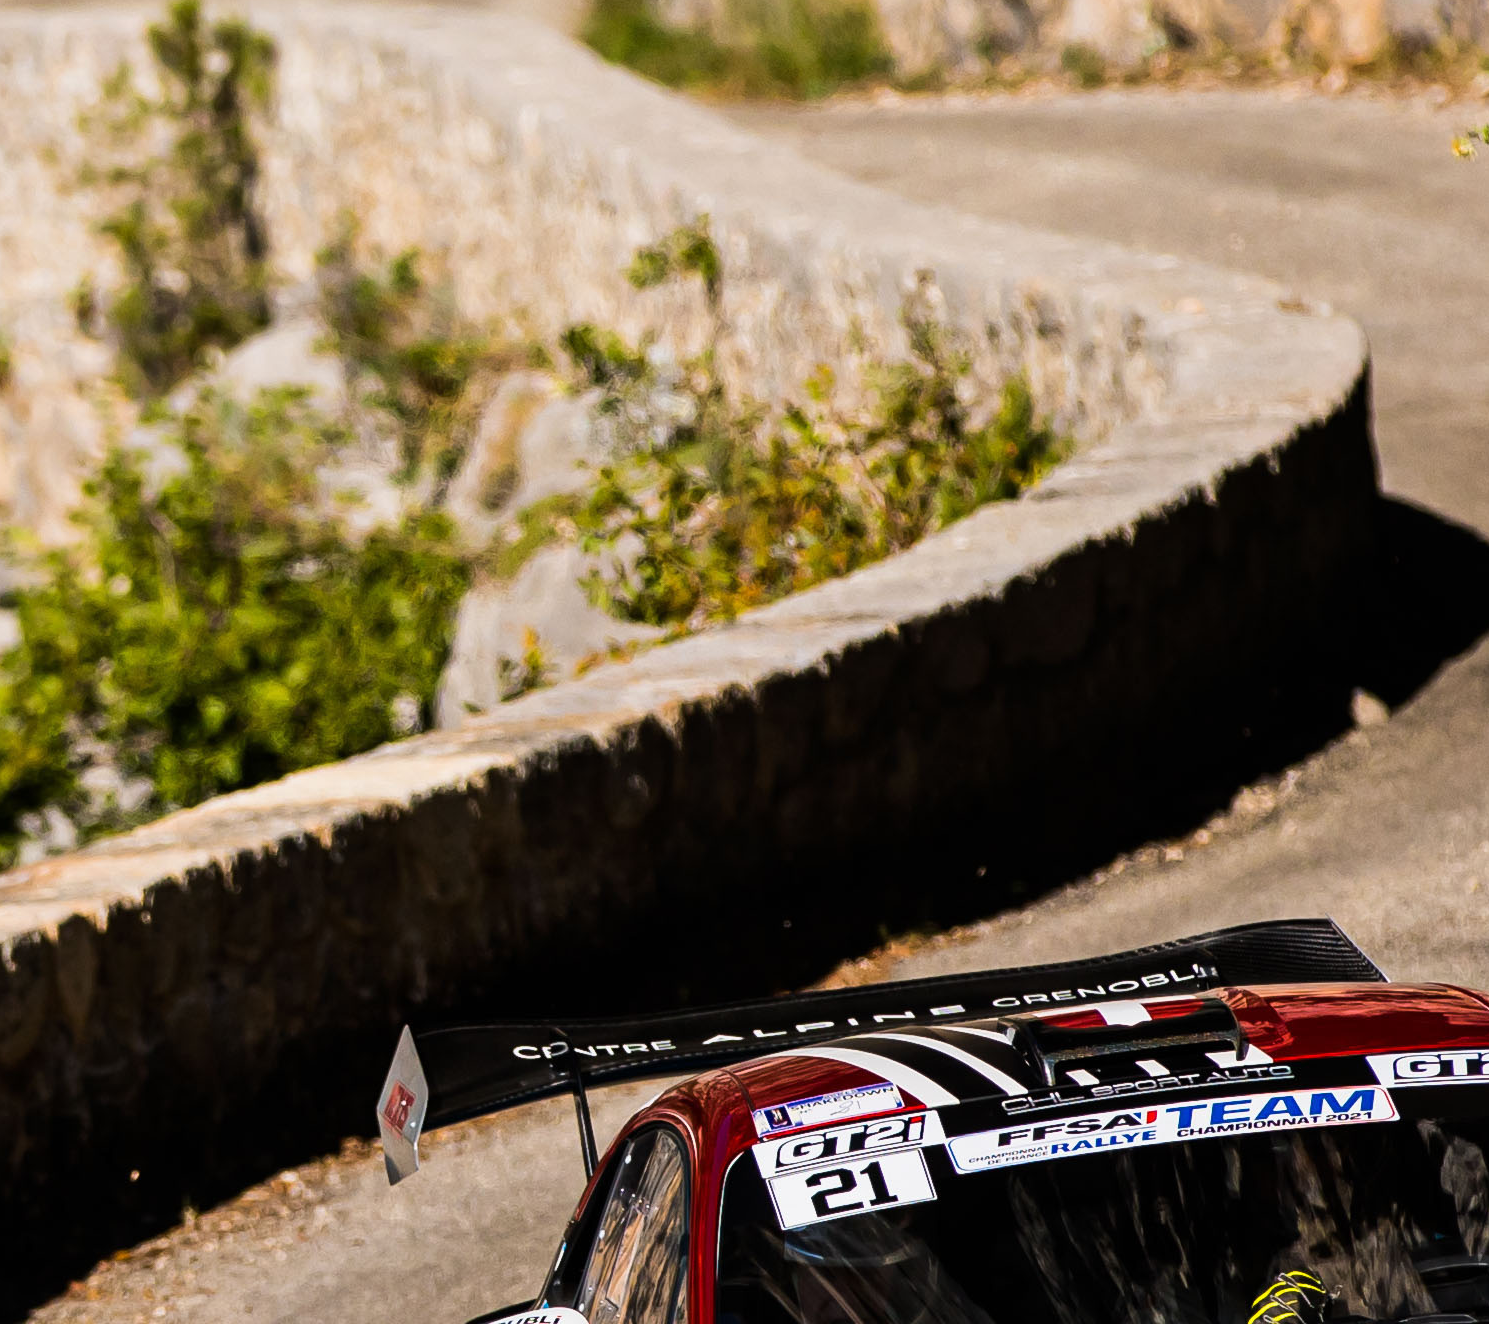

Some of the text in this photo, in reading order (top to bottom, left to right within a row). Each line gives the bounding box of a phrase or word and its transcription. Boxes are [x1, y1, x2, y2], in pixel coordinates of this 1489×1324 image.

[702, 1005, 967, 1046] ALPINE
[992, 963, 1204, 1007] GRENOBL
[789, 1086, 894, 1112] SHAKEDOWN
[1001, 1064, 1294, 1113] CHL SPORT AUTO
[997, 1089, 1376, 1147] FFSA TEAM
[1176, 1111, 1373, 1138] CHAMPIONNAT 2021
[775, 1114, 927, 1168] GT2i
[968, 1145, 1049, 1164] CHAMPIONNAT
[987, 1150, 1049, 1166] DE FRANCE
[1050, 1130, 1157, 1155] RALLYE
[804, 1160, 899, 1218] 21
